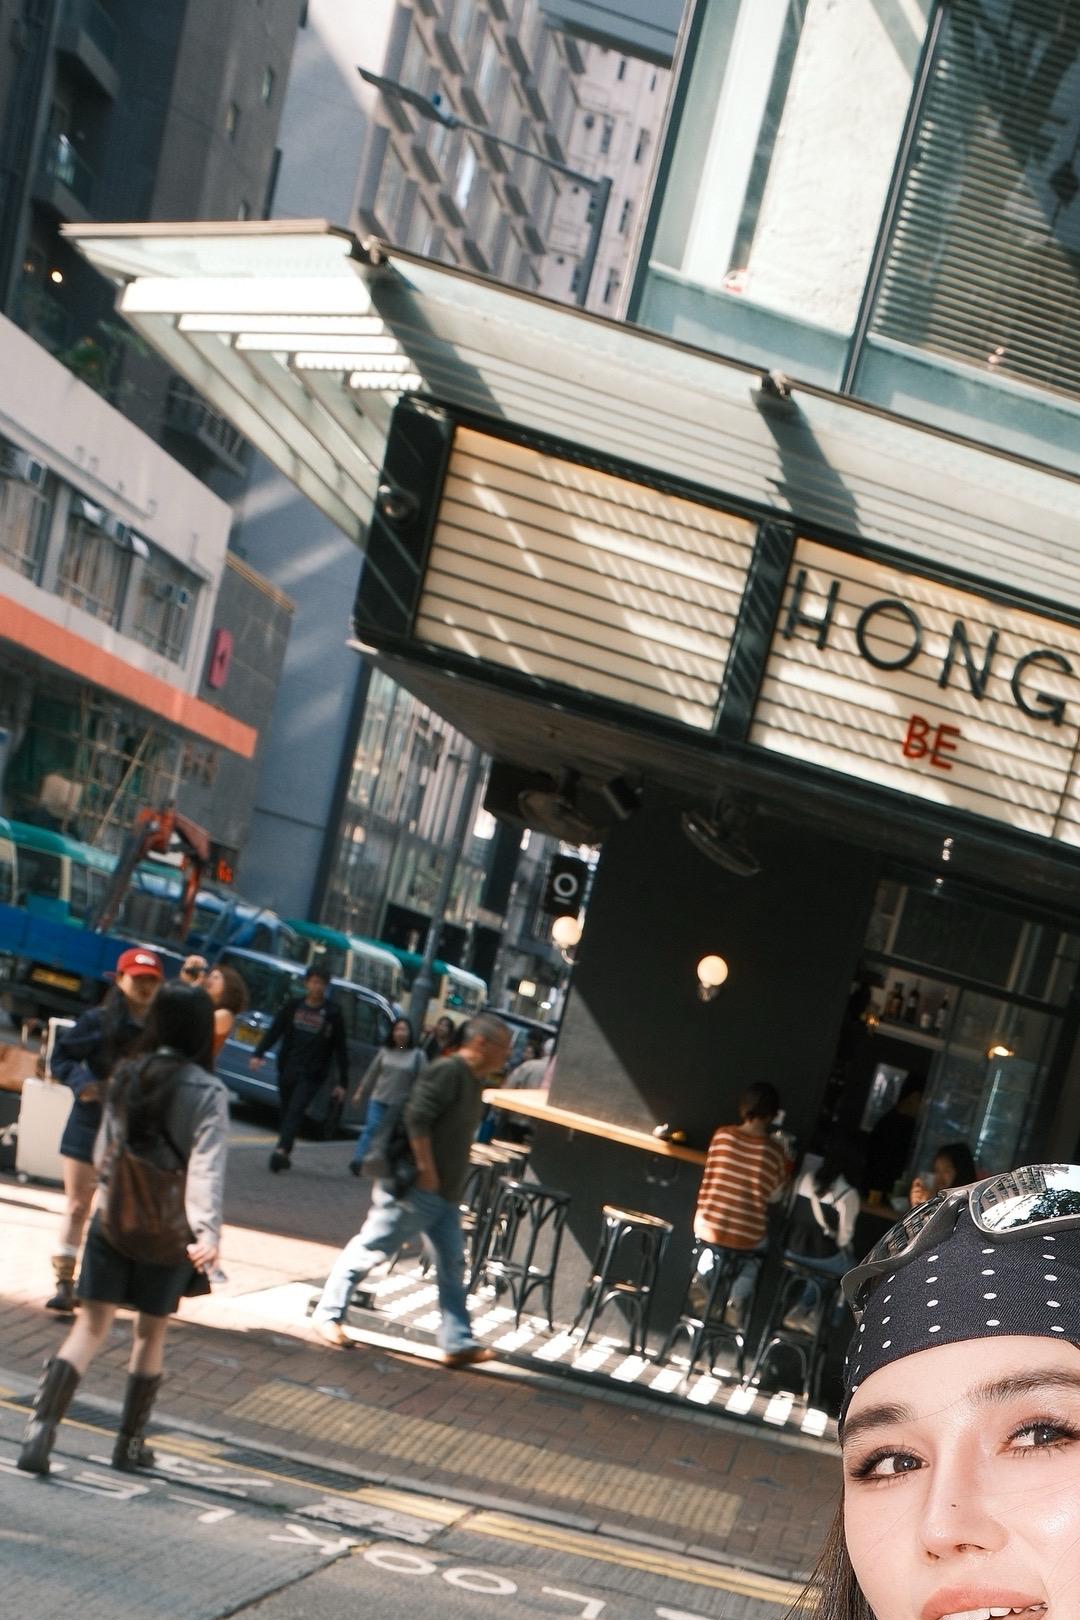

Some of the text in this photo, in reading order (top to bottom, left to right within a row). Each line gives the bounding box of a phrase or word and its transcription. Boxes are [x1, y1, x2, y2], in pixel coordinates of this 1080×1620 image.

[781, 568, 1074, 728] HONG
[902, 714, 961, 771] BE
[268, 1522, 607, 1620] LOOK
